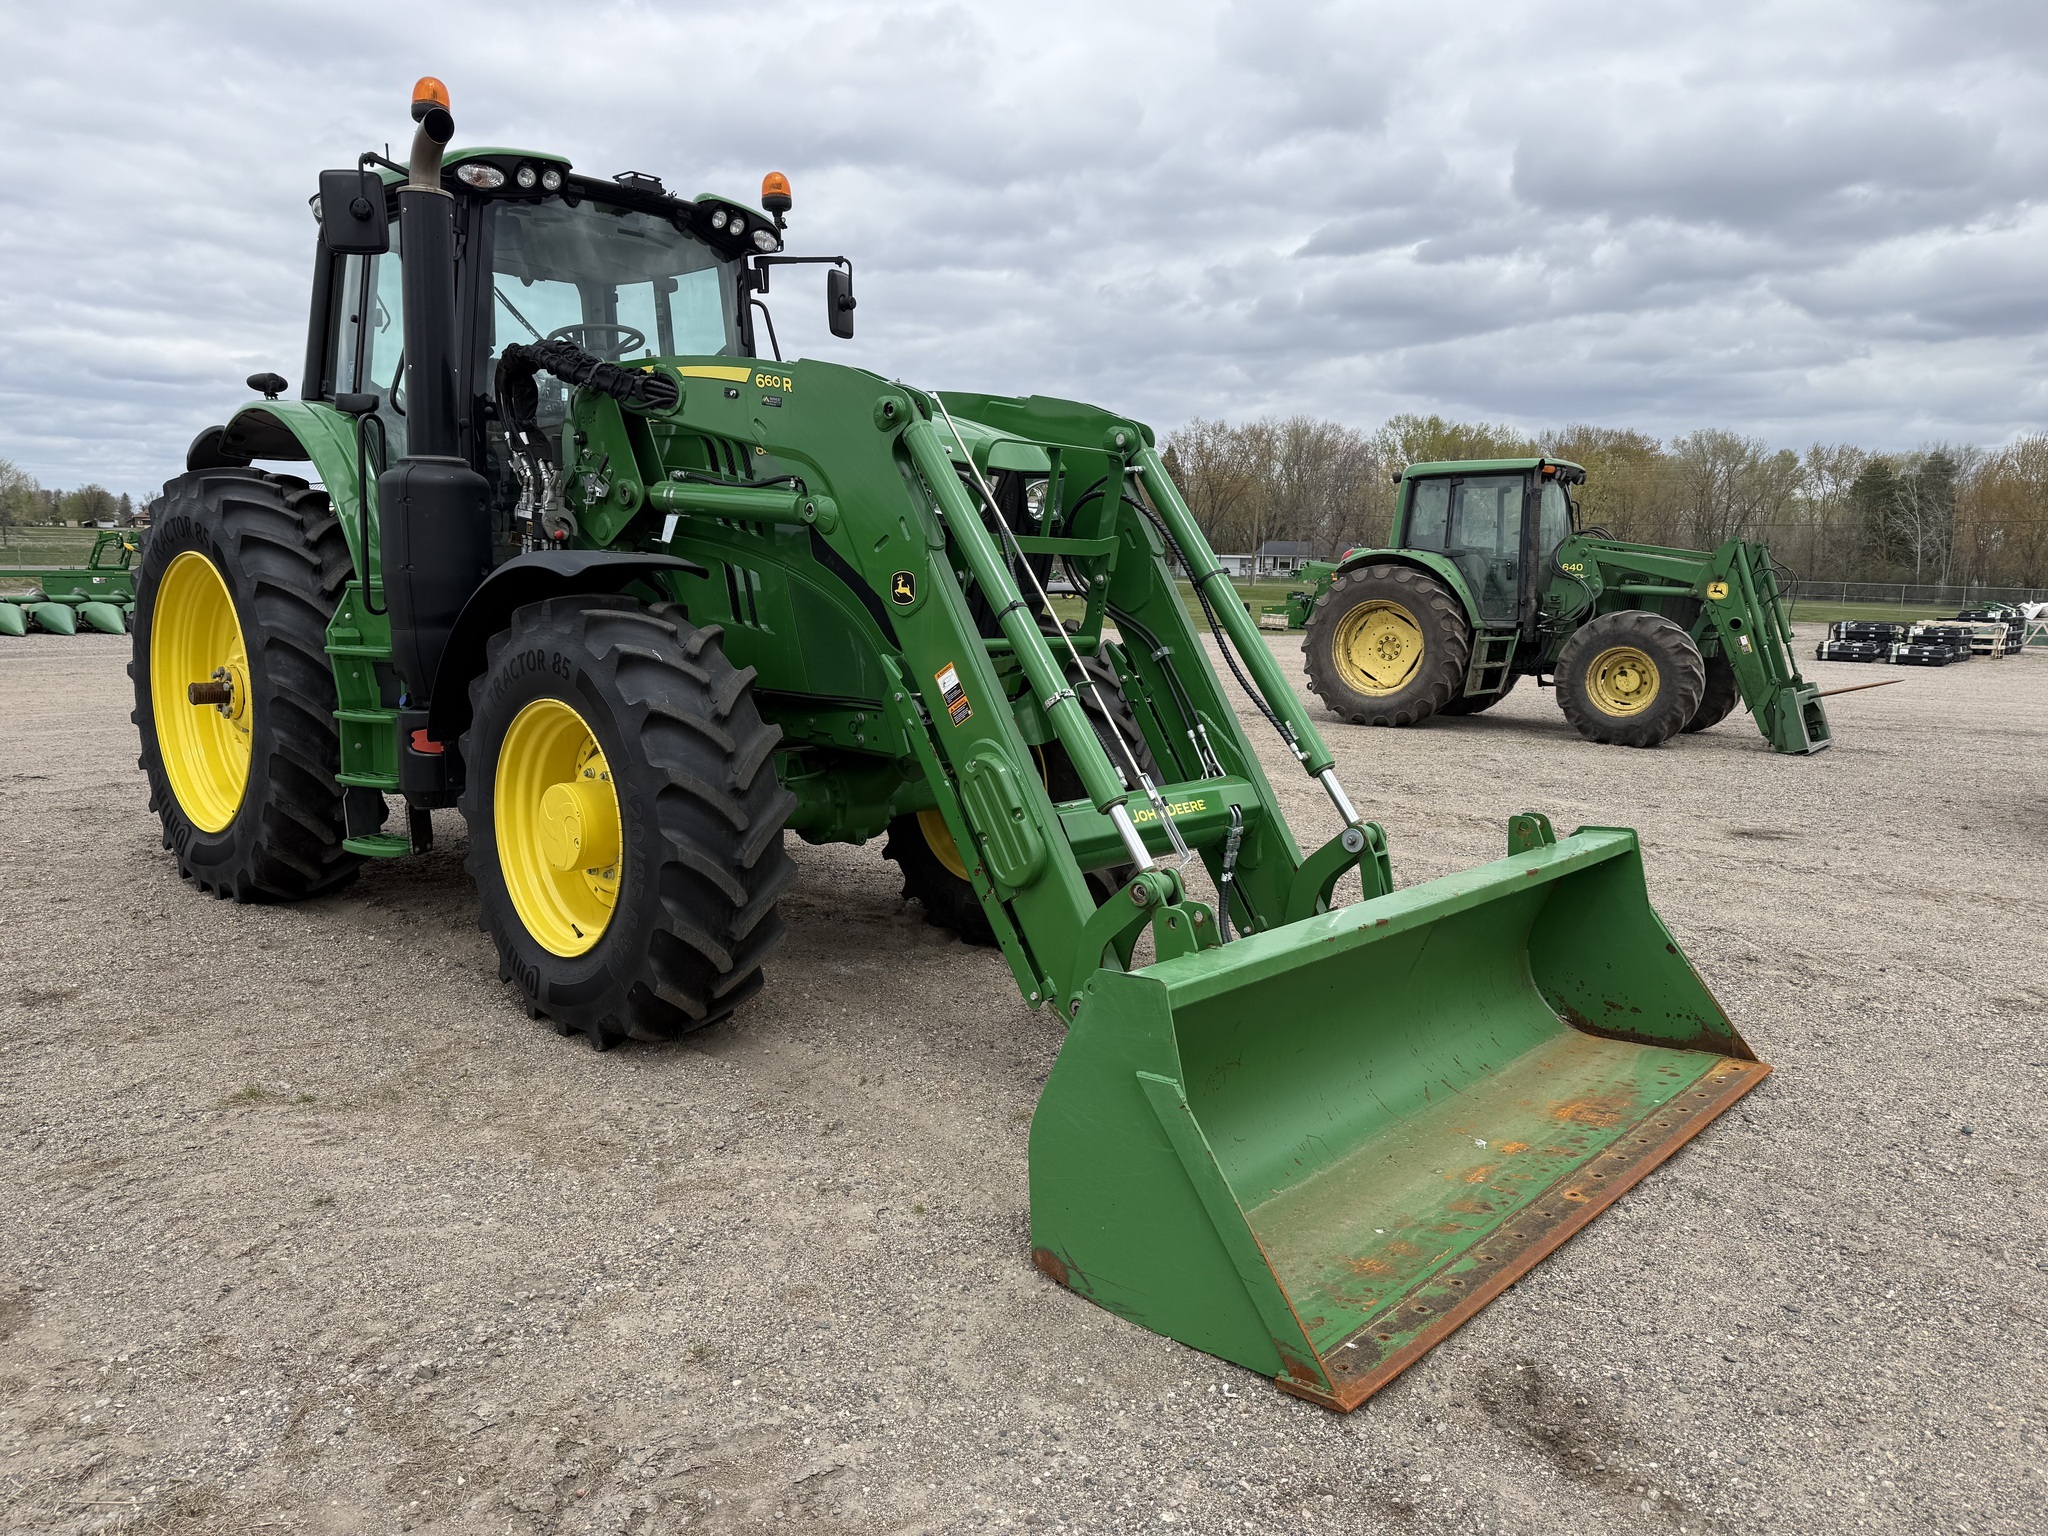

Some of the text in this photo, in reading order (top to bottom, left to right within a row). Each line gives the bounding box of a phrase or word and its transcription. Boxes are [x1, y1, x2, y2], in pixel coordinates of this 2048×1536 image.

[755, 373, 793, 393] 660 R
[149, 515, 210, 567] TRACTOR 85
[1562, 563, 1583, 571] 640
[487, 648, 572, 708] TRACTOR 85
[1167, 799, 1207, 817] DEERE
